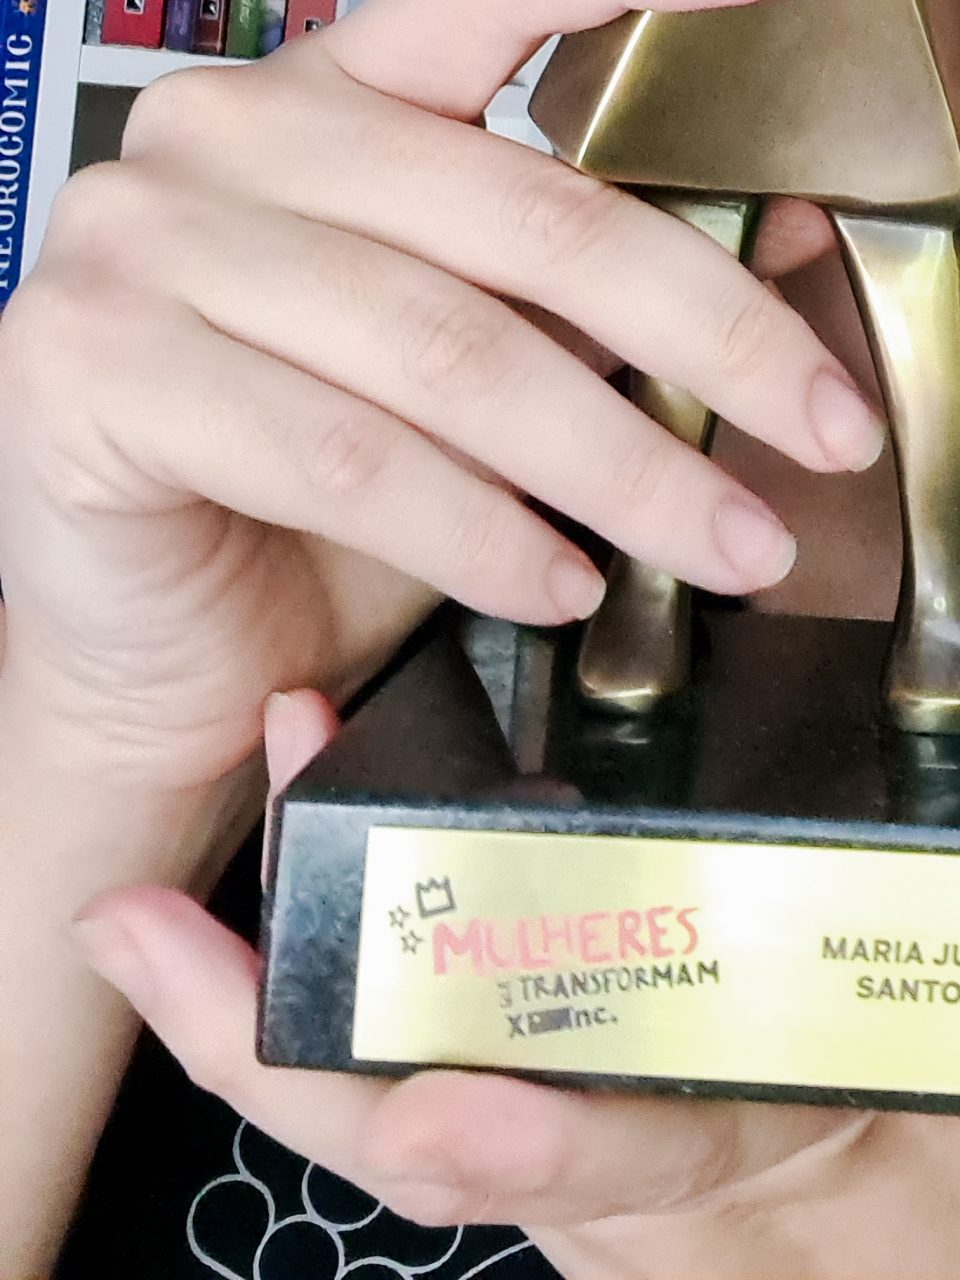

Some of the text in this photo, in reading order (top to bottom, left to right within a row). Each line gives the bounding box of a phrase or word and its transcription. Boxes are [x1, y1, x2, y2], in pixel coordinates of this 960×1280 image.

[432, 905, 701, 978] MULHERES
[821, 935, 925, 965] MARIA
[518, 960, 721, 1001] TRANSFORMAM
